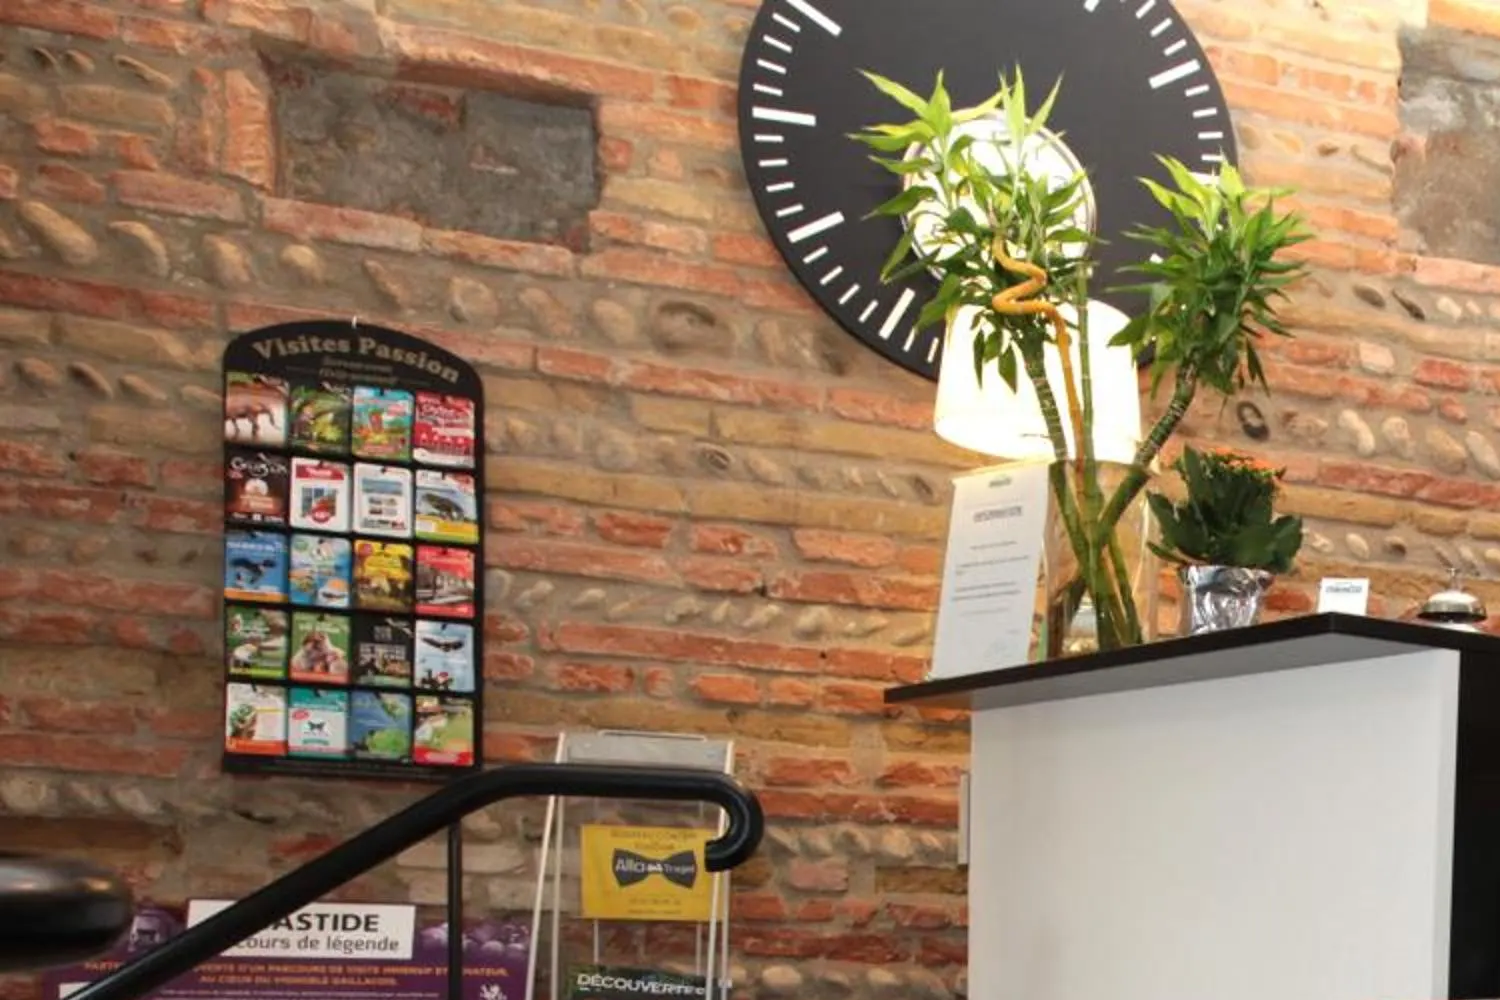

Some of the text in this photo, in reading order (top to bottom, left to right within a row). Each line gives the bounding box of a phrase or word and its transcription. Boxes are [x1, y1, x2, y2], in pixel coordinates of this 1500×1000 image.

[253, 335, 350, 360] Visites
[359, 335, 460, 384] Passion
[273, 913, 380, 932] ASTIDE
[236, 936, 400, 954] cours de légende
